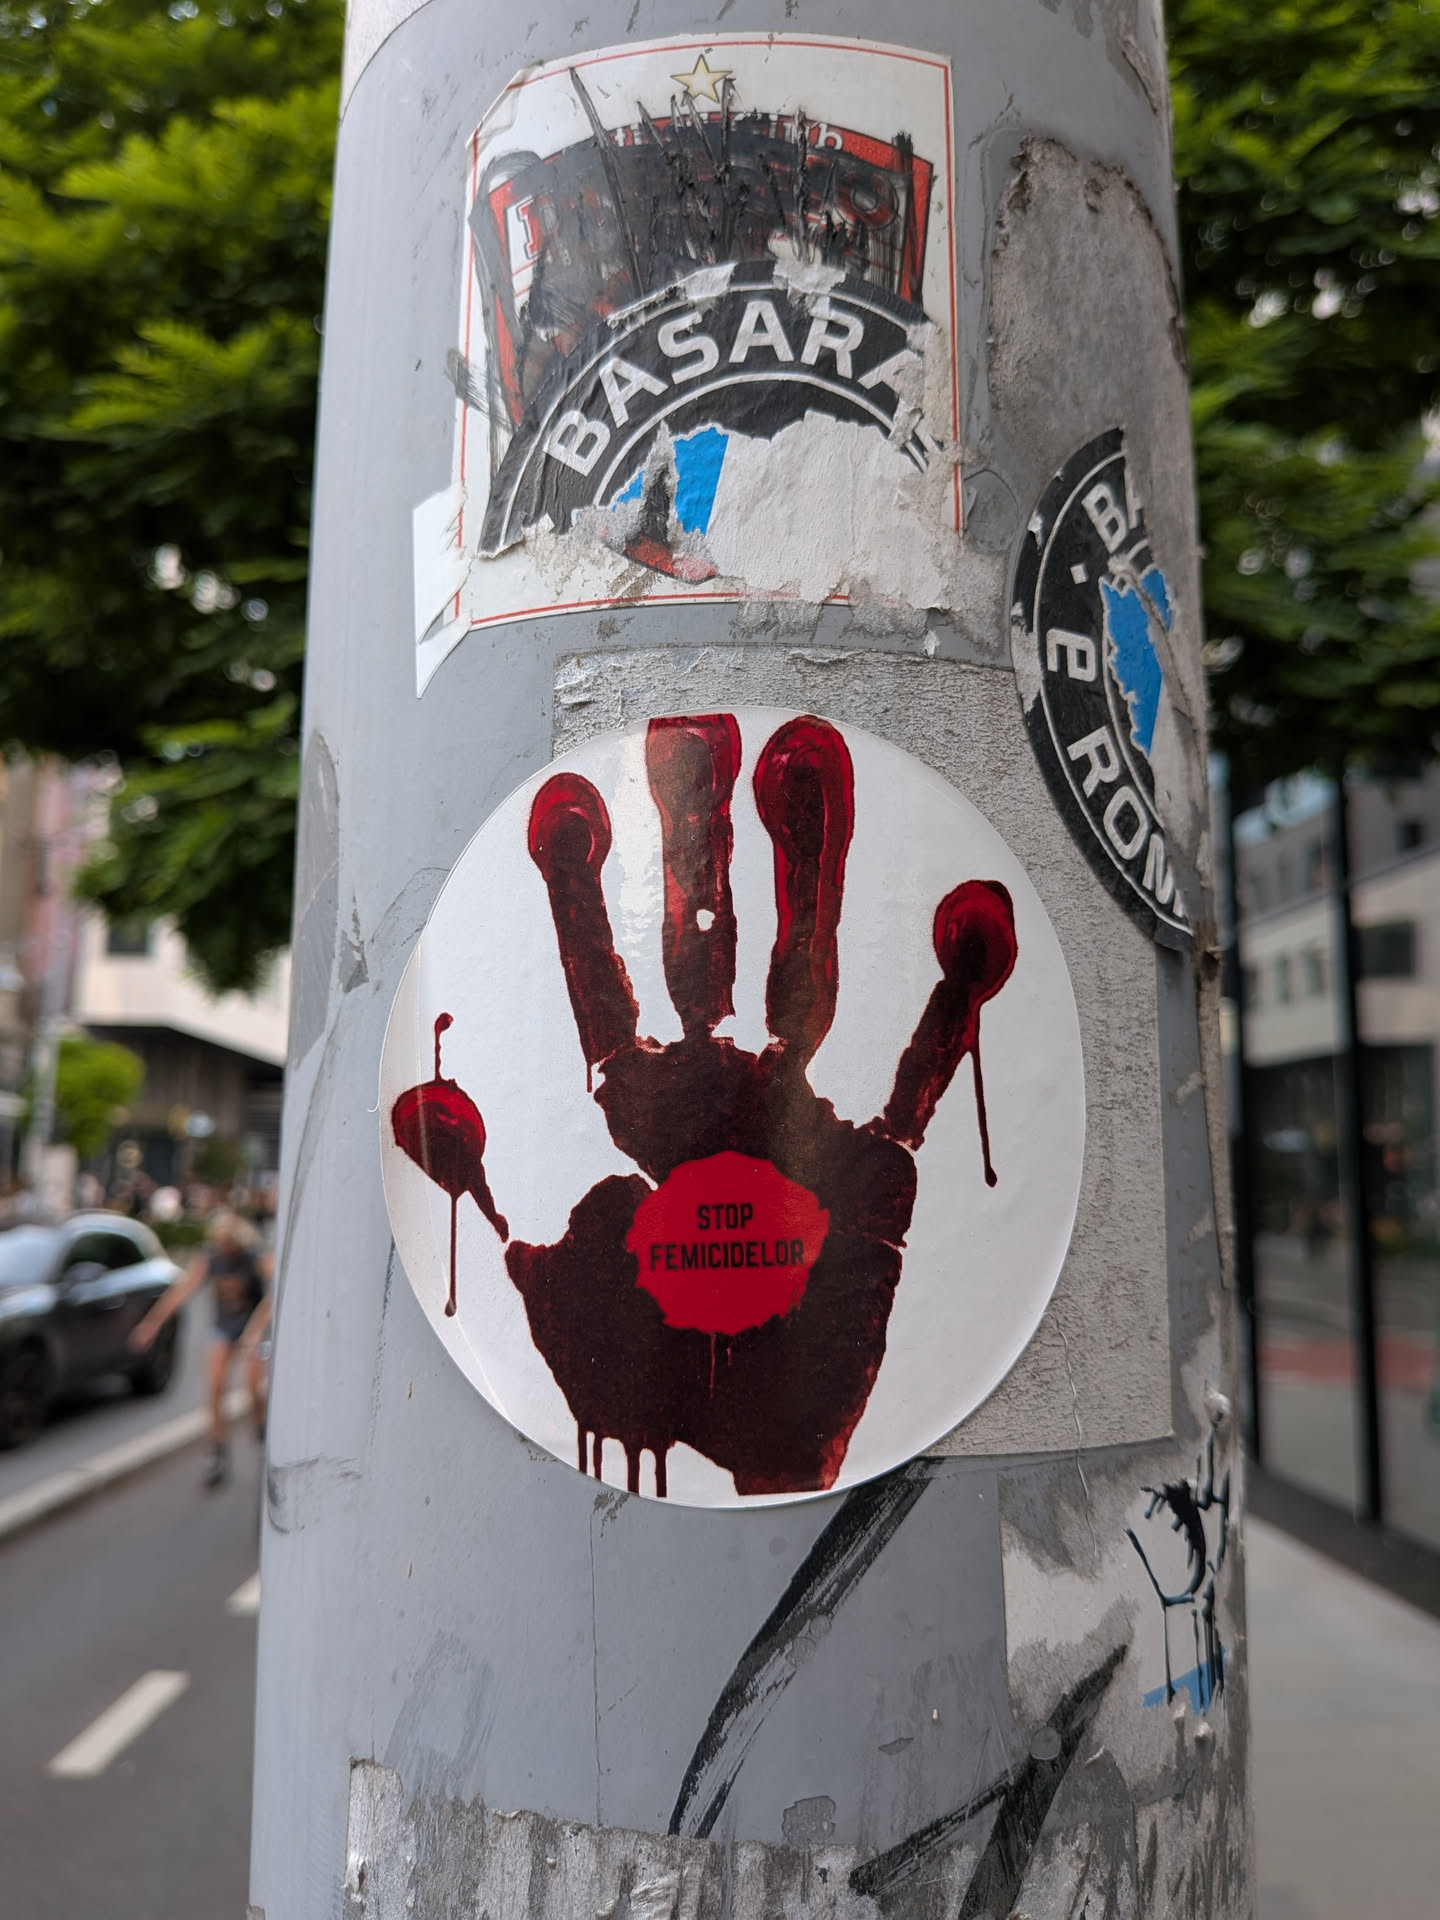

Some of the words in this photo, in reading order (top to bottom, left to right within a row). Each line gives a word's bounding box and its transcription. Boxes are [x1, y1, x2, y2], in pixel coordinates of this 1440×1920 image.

[543, 299, 943, 477] BASARA
[697, 1202, 754, 1231] STOP
[650, 1238, 805, 1272] FEMICIDELOR
